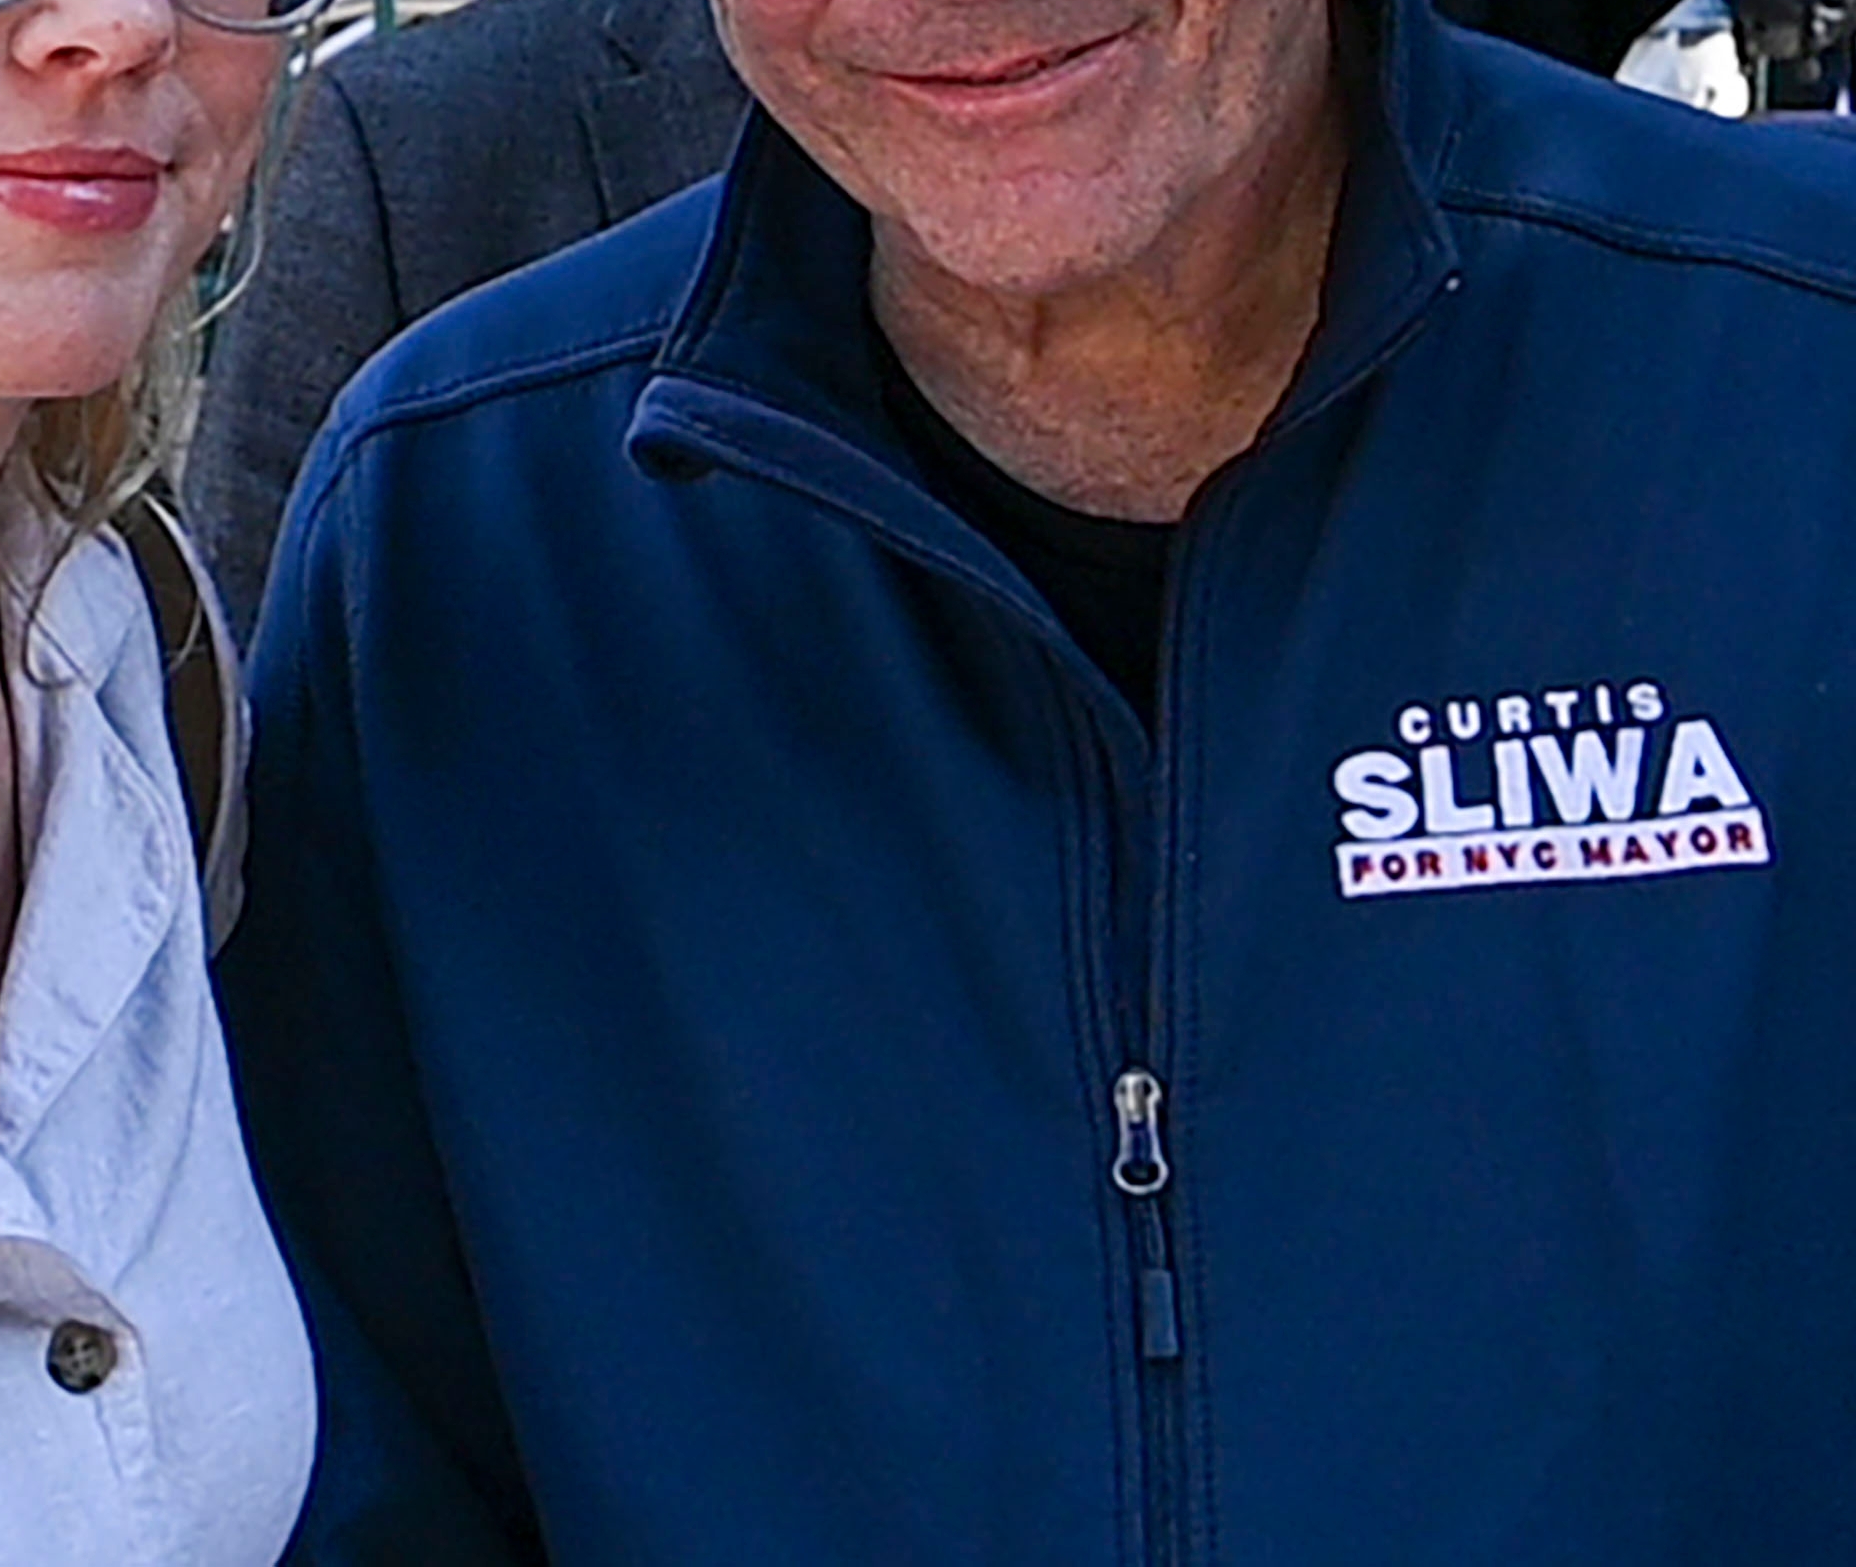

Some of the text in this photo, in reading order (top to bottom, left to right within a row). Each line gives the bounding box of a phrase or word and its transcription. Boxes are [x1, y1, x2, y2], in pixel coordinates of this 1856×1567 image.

[1398, 682, 1664, 745] CURTIS
[1333, 719, 1751, 841] SLIWA
[1350, 820, 1754, 885] FOR NYC MAYOR
